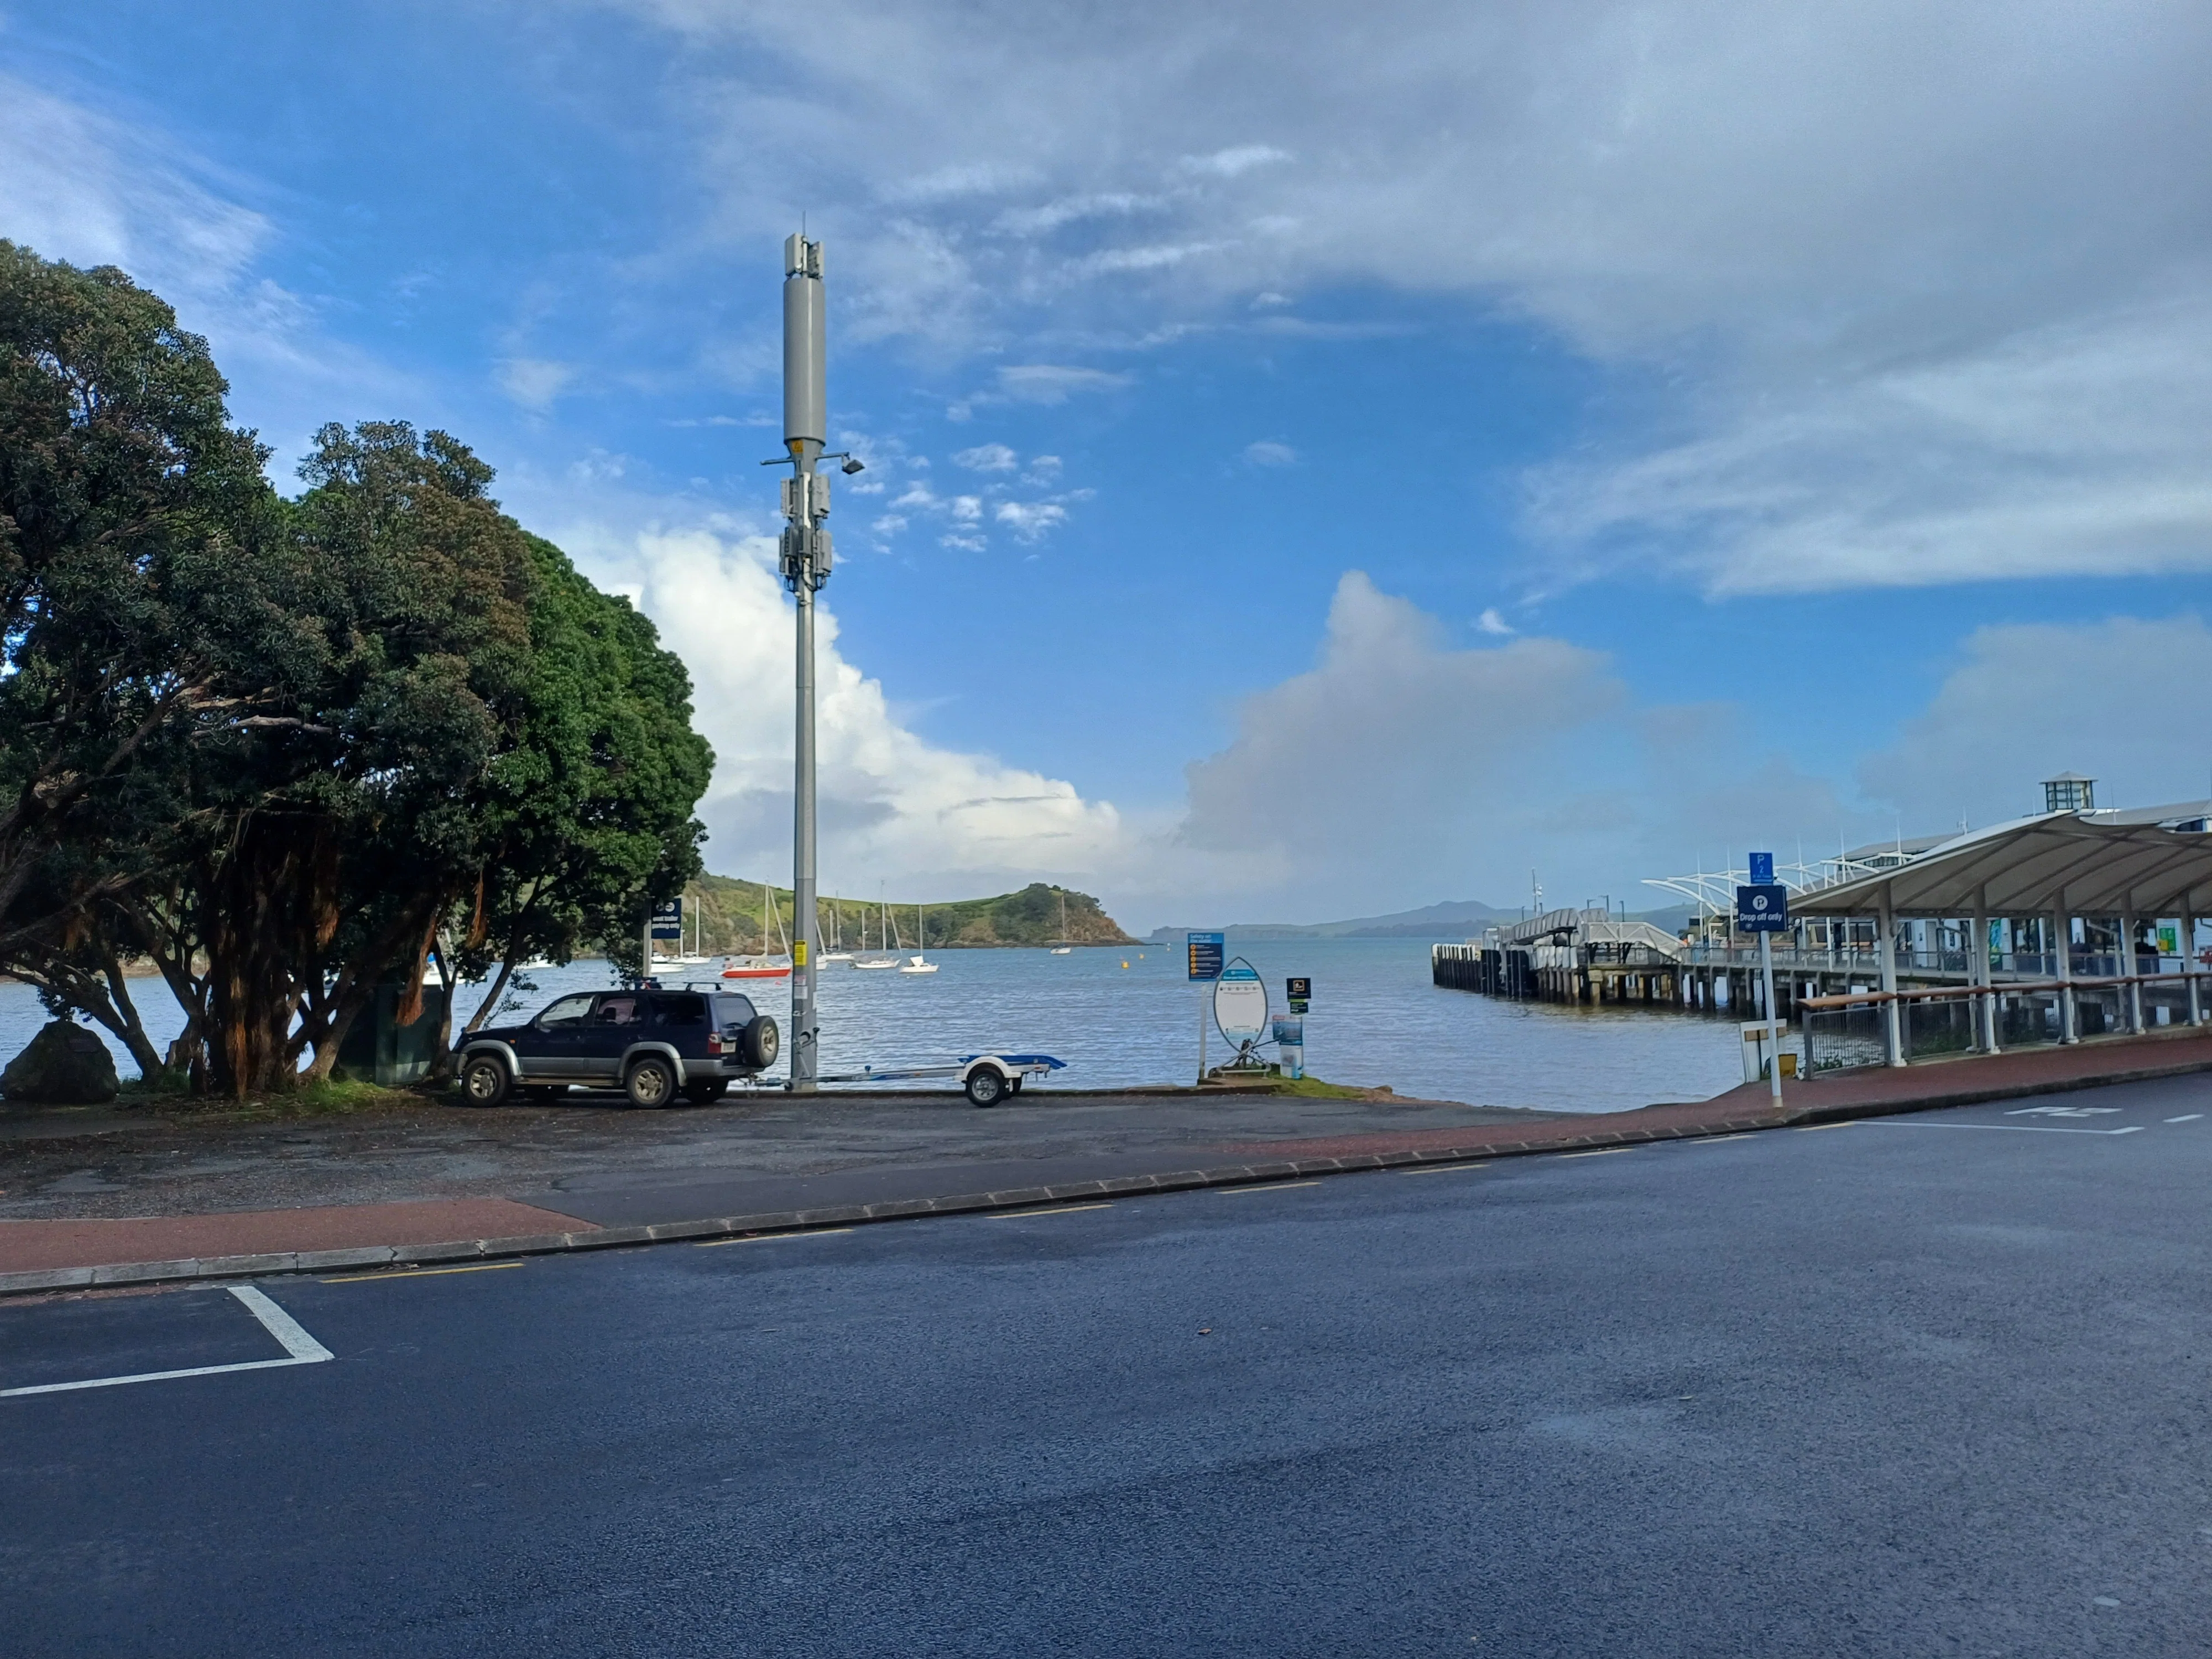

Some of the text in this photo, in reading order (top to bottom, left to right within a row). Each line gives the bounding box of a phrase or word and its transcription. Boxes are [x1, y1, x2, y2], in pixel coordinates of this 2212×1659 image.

[1757, 854, 1765, 864] P
[1757, 898, 1764, 907] P
[1740, 912, 1782, 922] Drop off only
